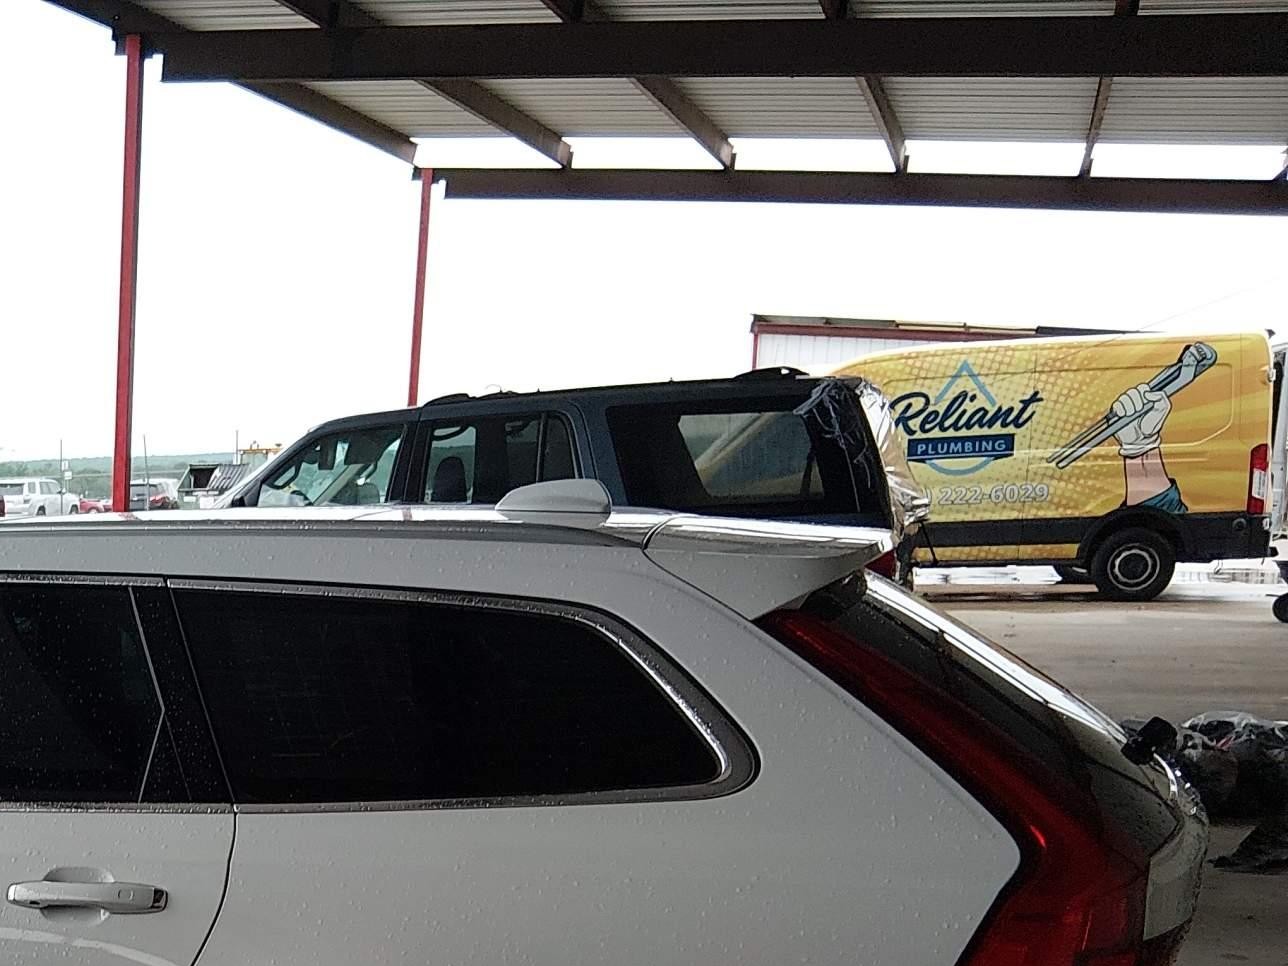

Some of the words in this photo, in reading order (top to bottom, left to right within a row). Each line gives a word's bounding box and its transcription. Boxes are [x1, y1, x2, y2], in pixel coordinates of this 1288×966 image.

[889, 390, 1044, 436] Reliant
[916, 440, 1006, 455] PLUMBING
[938, 482, 1050, 506] 222-6029
